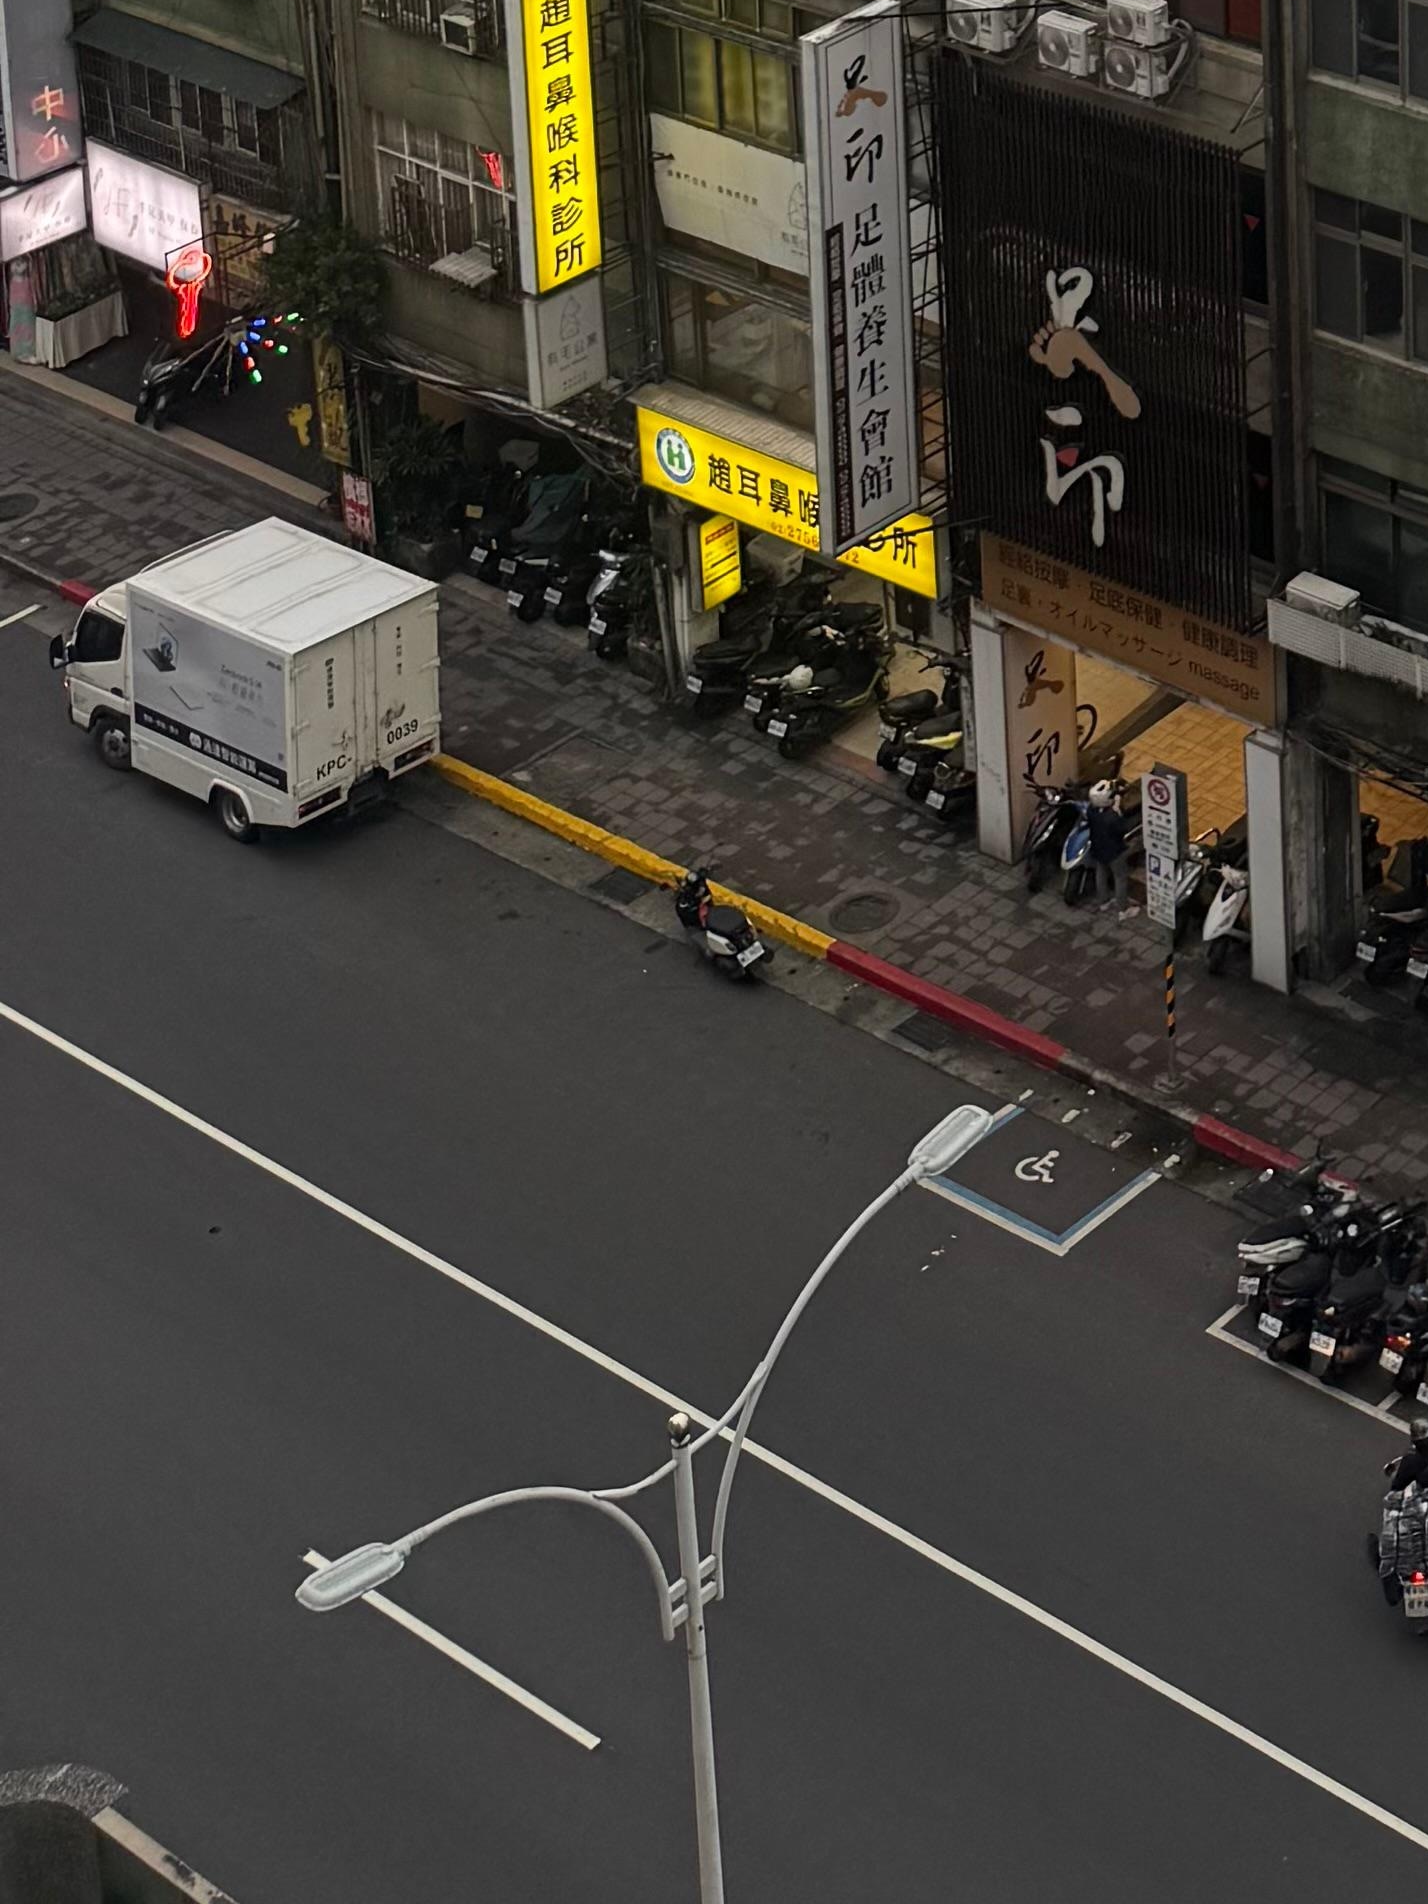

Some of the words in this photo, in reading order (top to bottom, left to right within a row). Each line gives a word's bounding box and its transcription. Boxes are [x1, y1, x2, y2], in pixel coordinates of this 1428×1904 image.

[849, 201, 894, 509] 足體養生會館
[1188, 659, 1261, 702] massage
[386, 718, 419, 745] 0039
